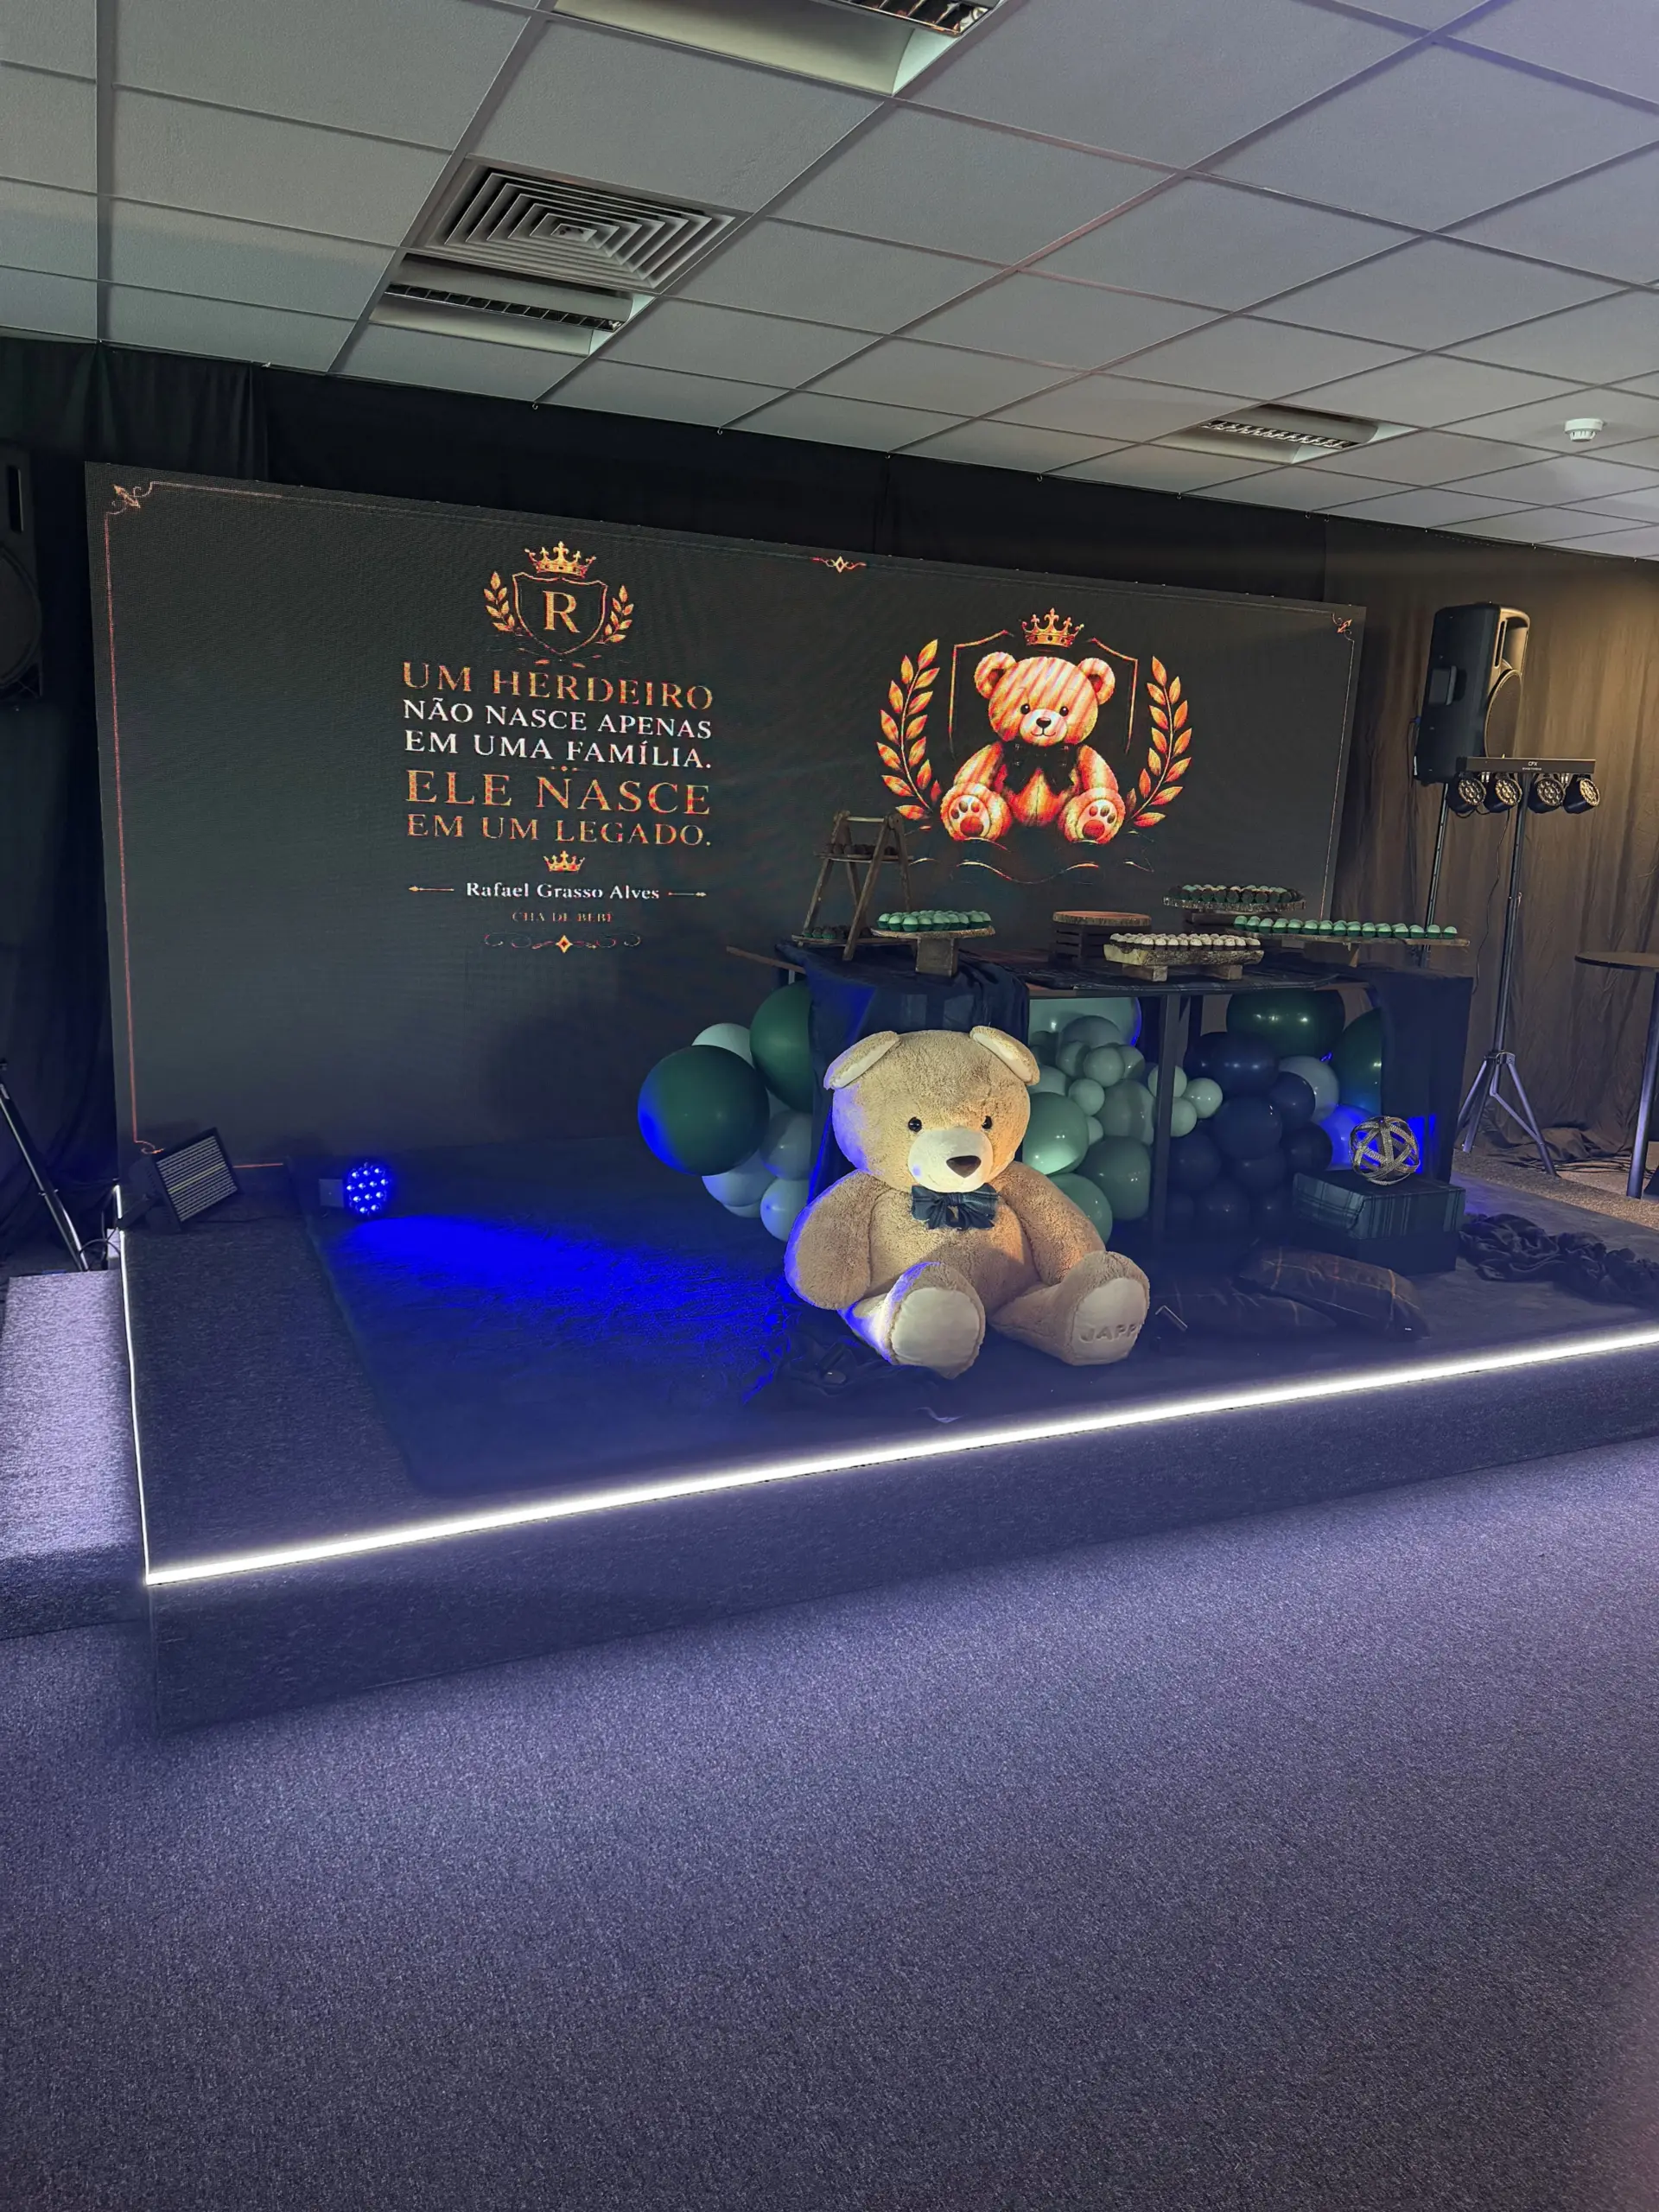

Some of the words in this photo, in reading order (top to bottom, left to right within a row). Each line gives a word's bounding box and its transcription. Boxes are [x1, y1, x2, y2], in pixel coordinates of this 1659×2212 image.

[543, 590, 581, 633] R
[403, 662, 472, 692] UM
[493, 670, 713, 709] HERDEIRO
[403, 697, 474, 723] NÃO
[486, 705, 587, 731] NASCE
[597, 714, 712, 740] APENAS
[404, 729, 458, 754] EM
[474, 734, 553, 760] UMA
[567, 741, 712, 769] FAMÍLIA.
[405, 769, 512, 806] ELE
[537, 776, 710, 815] NASCE
[407, 814, 463, 838] EM
[482, 817, 538, 841] UM
[555, 820, 712, 847] LEGADO.
[466, 882, 529, 899] Rafael
[537, 884, 603, 899] Grasso
[609, 886, 660, 899] Alves
